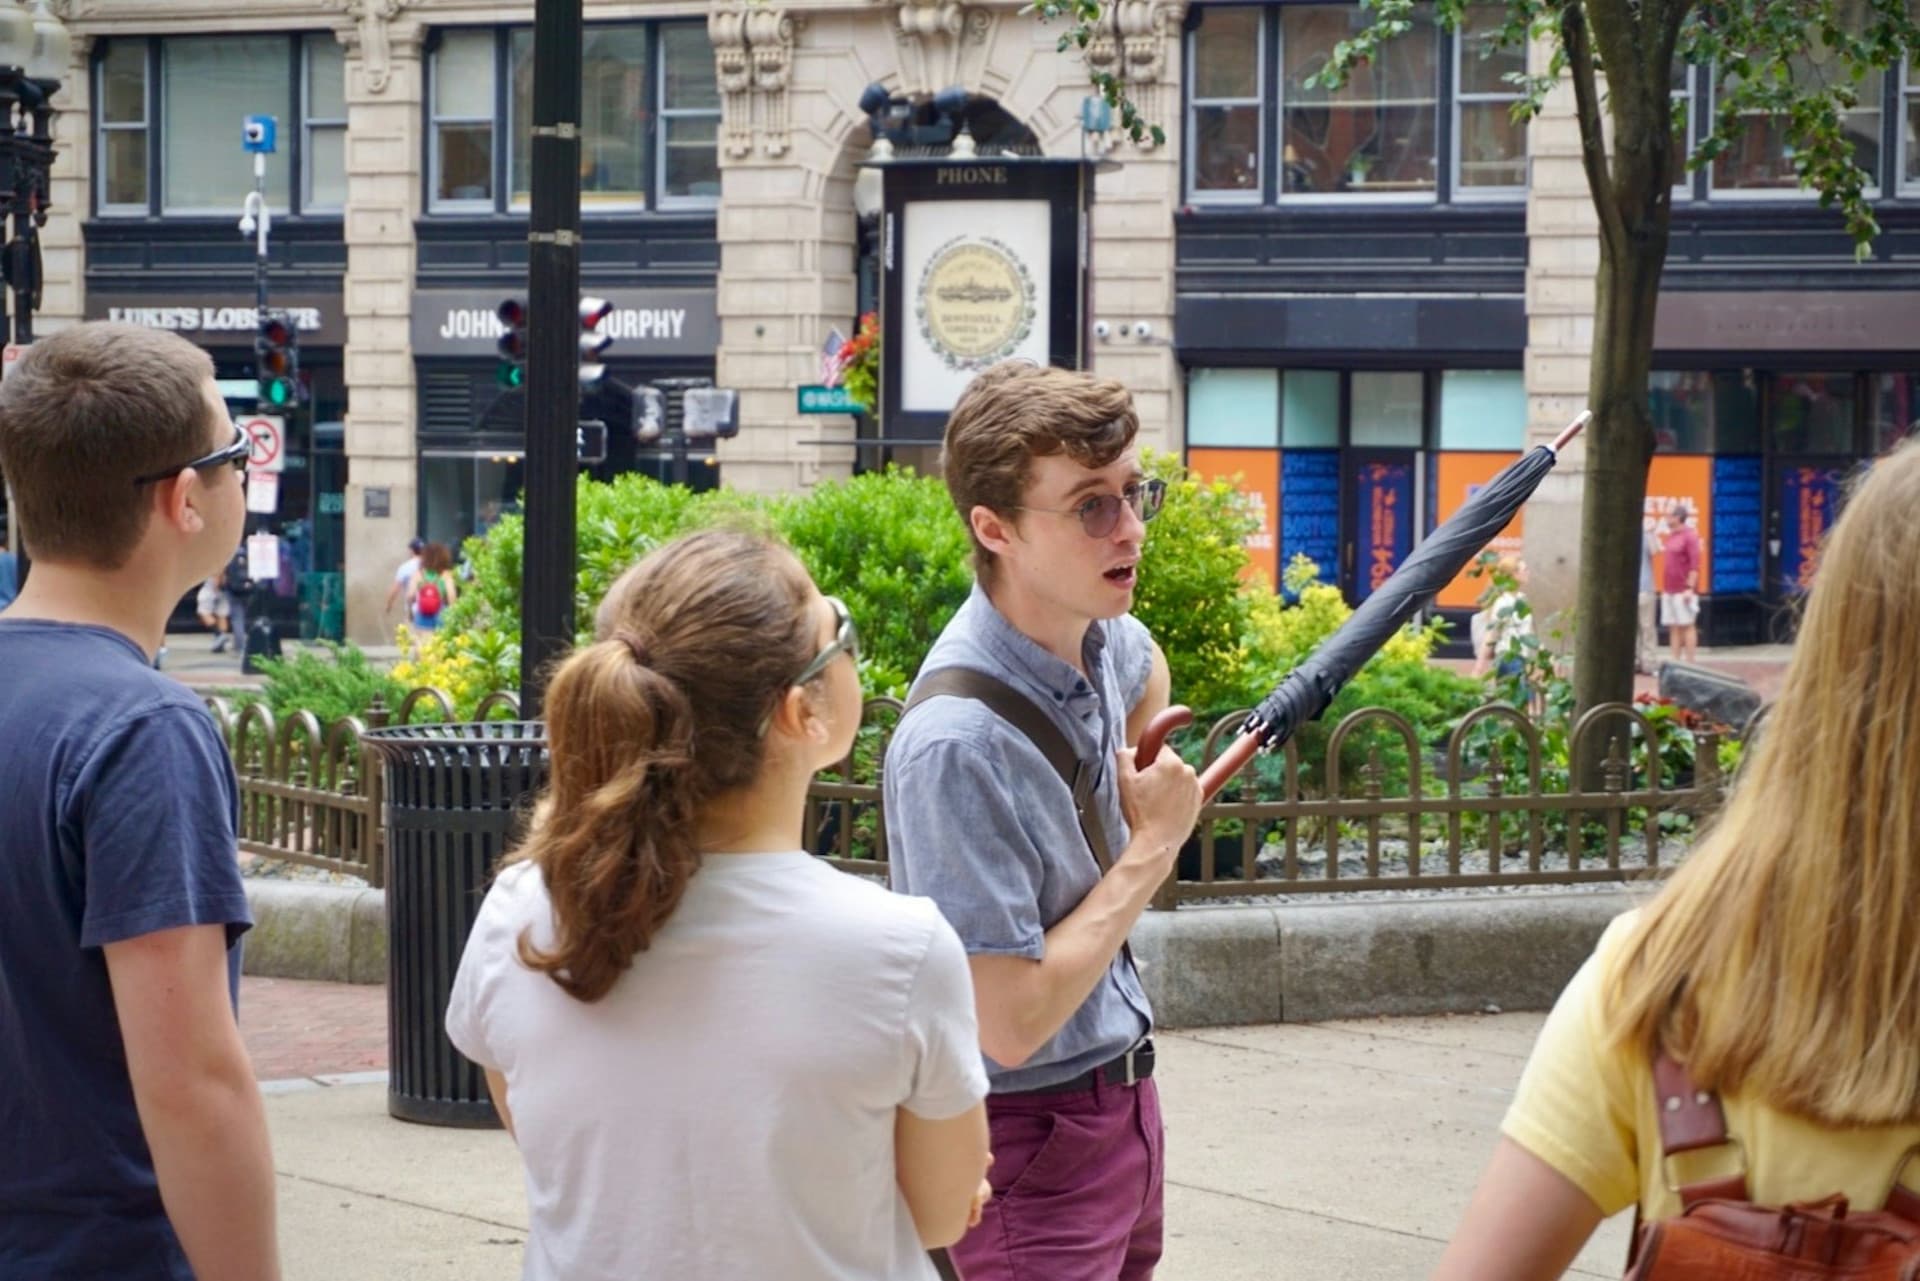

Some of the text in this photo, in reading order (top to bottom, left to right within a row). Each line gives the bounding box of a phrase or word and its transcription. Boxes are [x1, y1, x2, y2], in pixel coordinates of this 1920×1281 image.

[936, 167, 1008, 184] PHONE
[108, 307, 321, 330] LUKE'S LOBER
